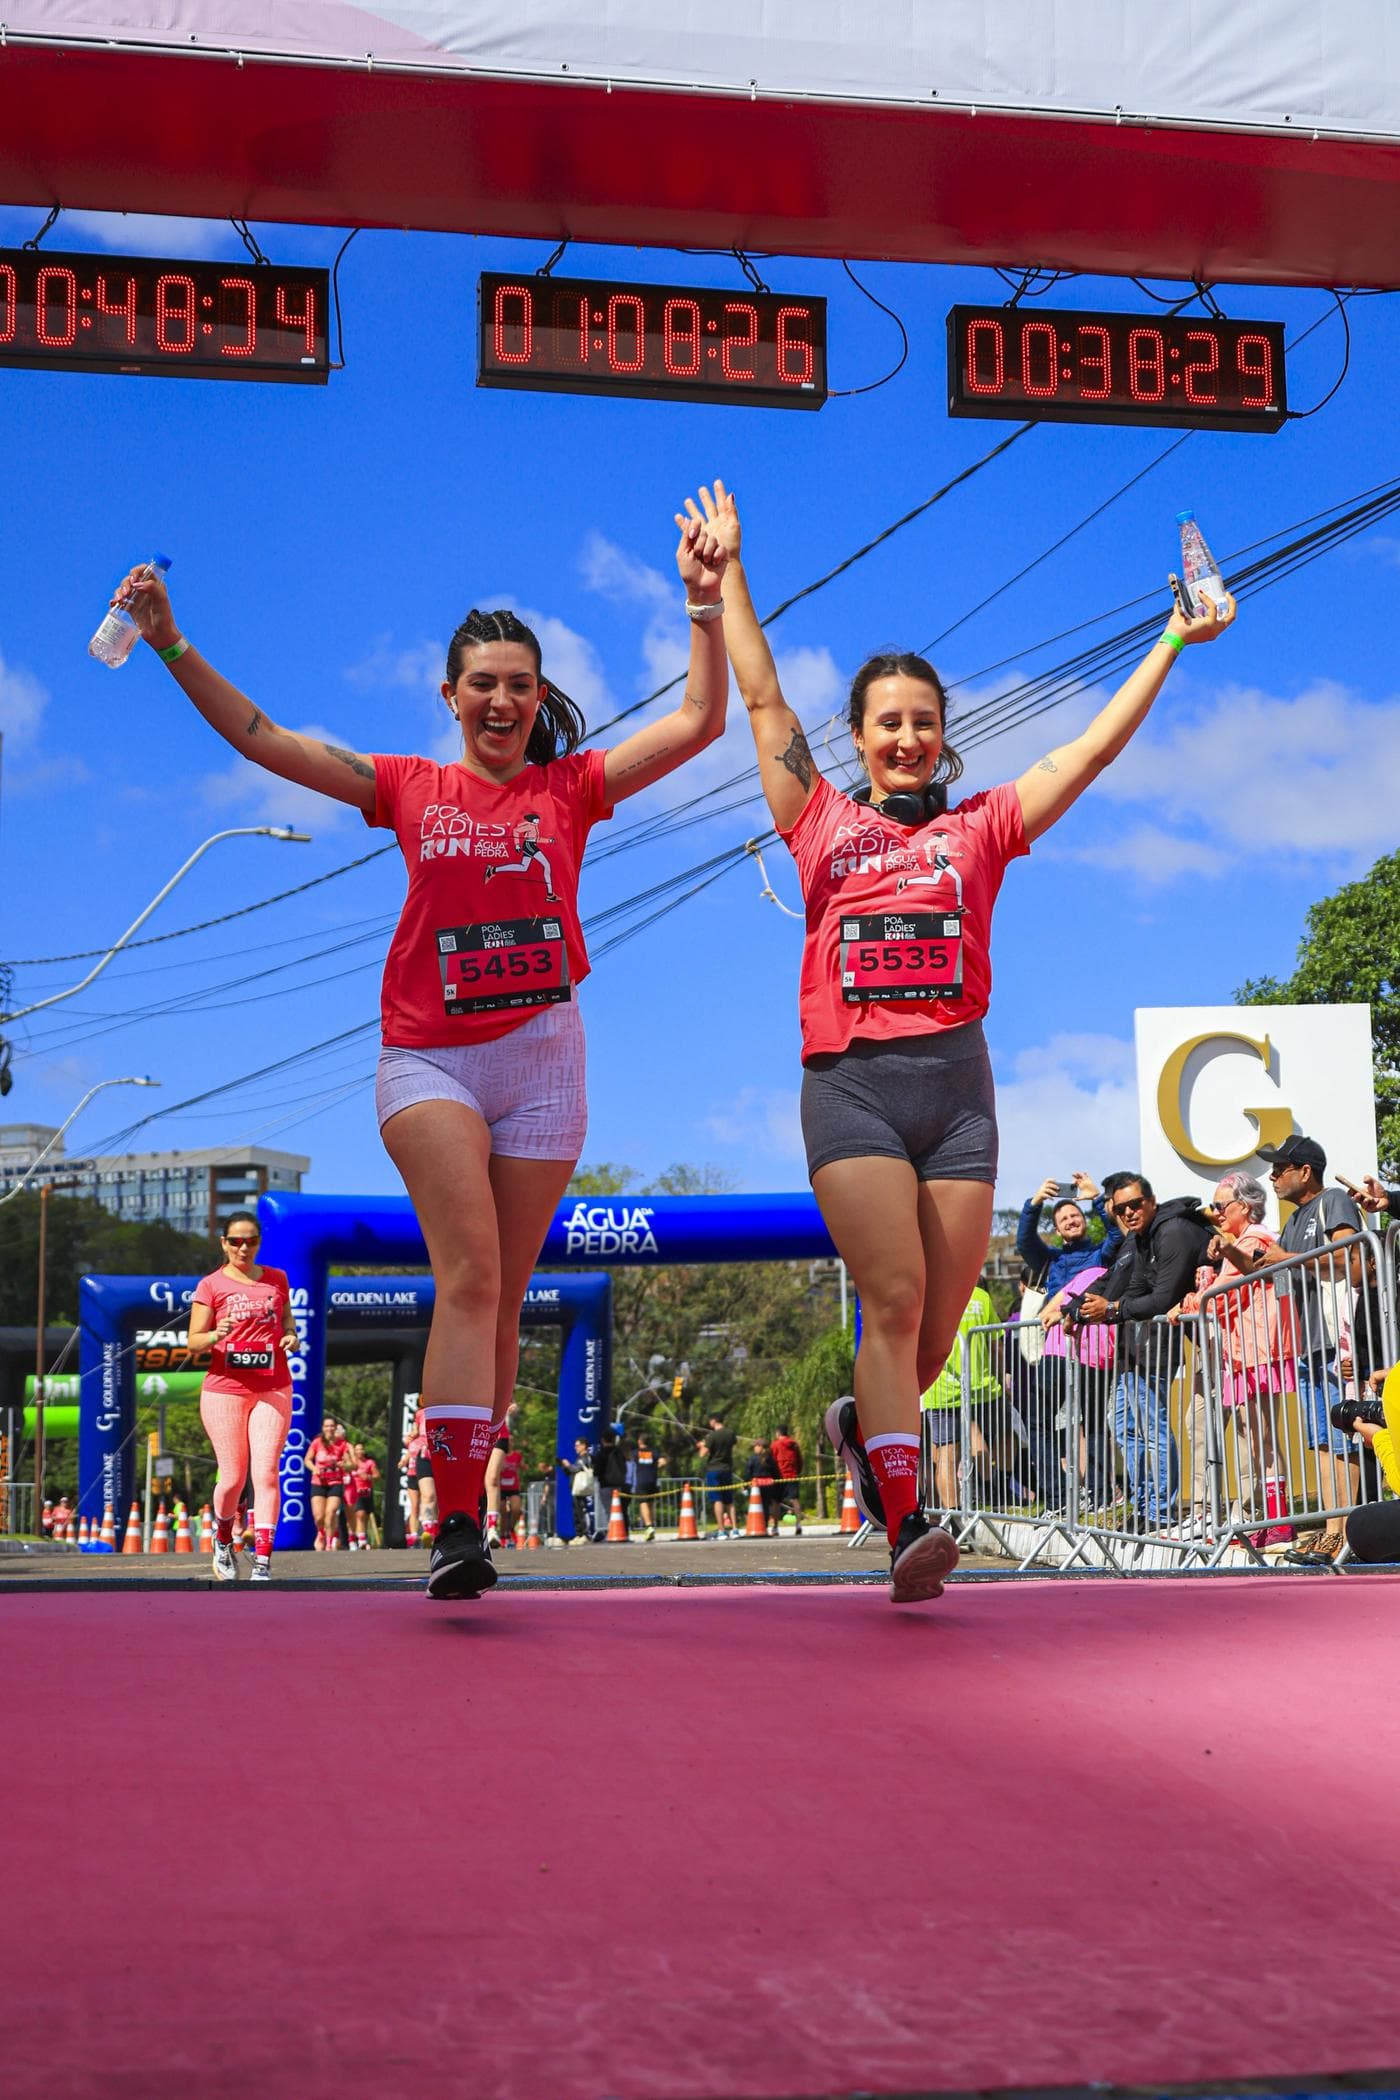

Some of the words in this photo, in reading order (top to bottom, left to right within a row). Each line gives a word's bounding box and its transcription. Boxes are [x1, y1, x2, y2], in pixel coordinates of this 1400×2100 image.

[494, 284, 814, 384] 01:08:26
[967, 318, 1274, 407] 00:38:29
[423, 804, 470, 821] POA
[834, 822, 885, 840] POA
[420, 837, 471, 862] RUN
[474, 849, 510, 858] PEDRA
[830, 854, 882, 880] RUN
[885, 863, 921, 873] PEDRA
[481, 924, 502, 934] POA
[884, 916, 904, 925] POA
[484, 939, 505, 950] RUN
[884, 932, 905, 941] RUN
[460, 948, 553, 983] 5453
[859, 944, 950, 973] 5535
[1157, 1030, 1293, 1166] G
[562, 1202, 650, 1231] ÁGUA
[566, 1230, 659, 1255] PEDRA
[331, 1292, 384, 1305] GOLDEN
[386, 1291, 418, 1304] LAKE
[528, 1289, 560, 1302] LAKE
[232, 1353, 269, 1364] 3970
